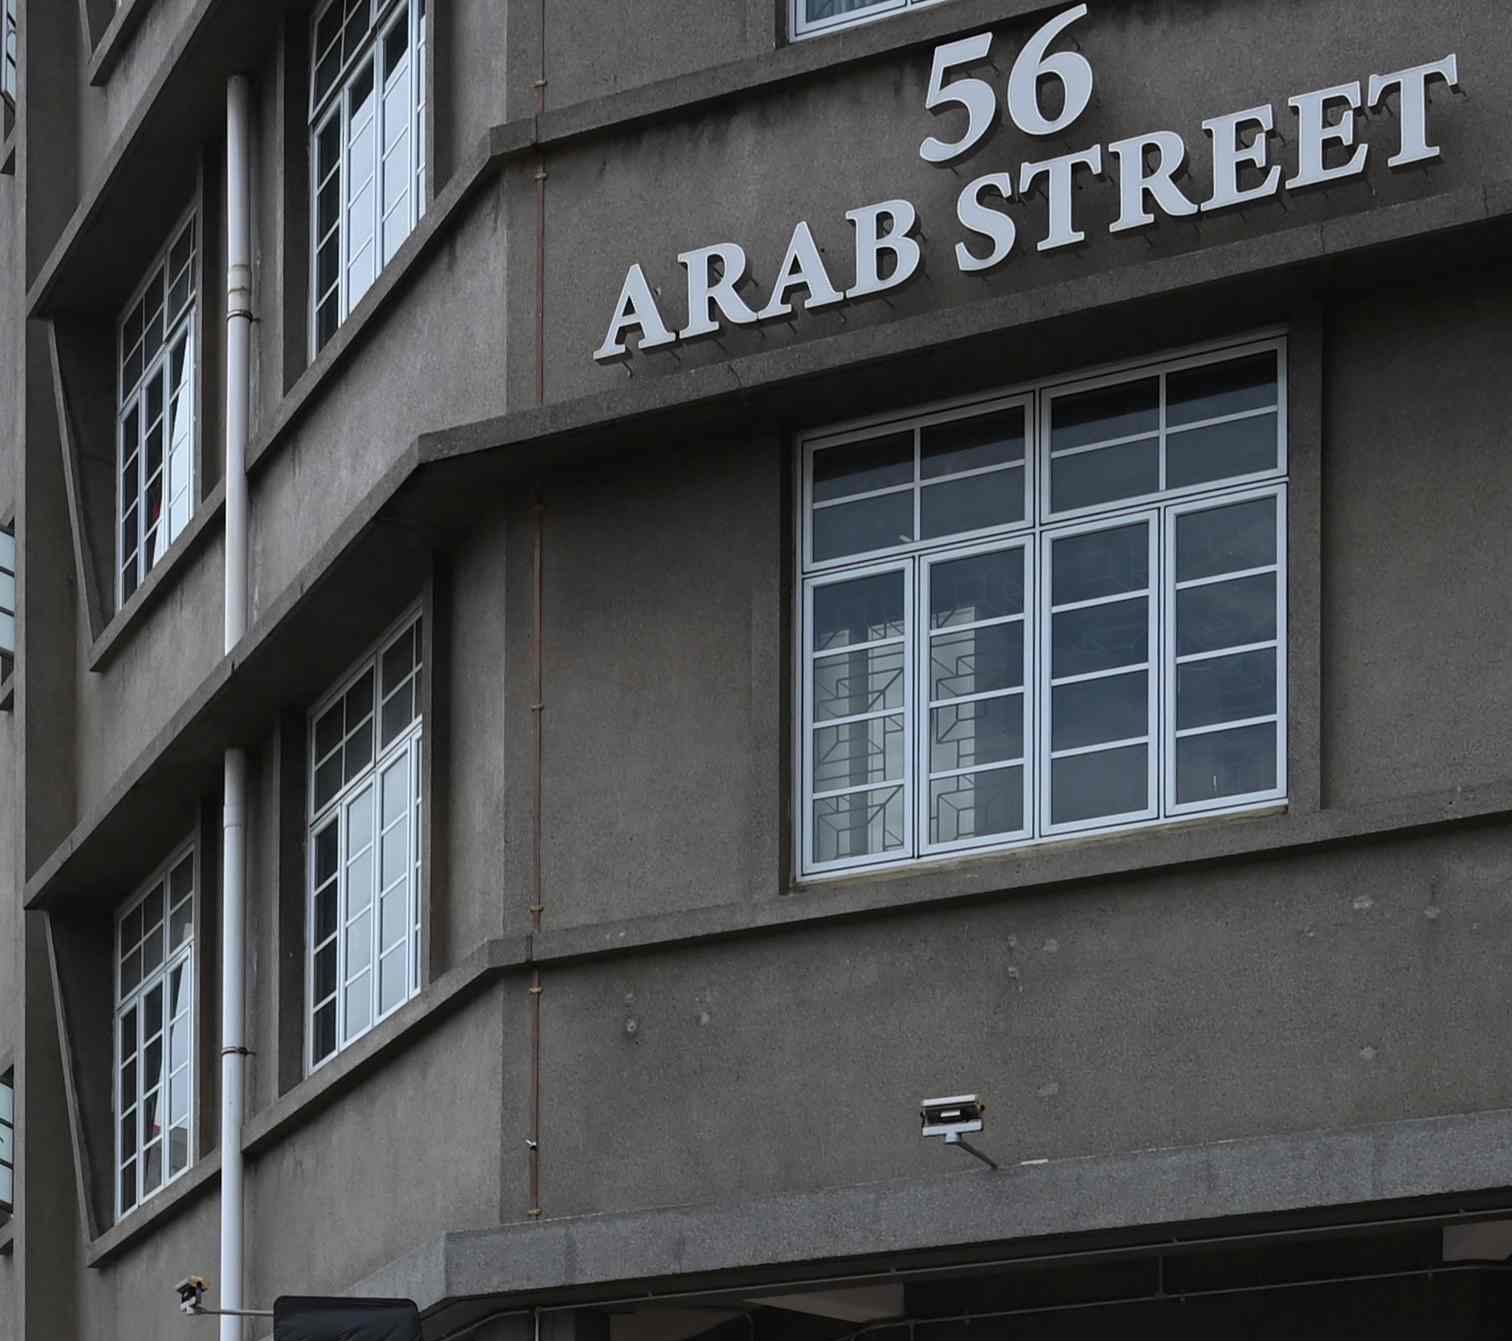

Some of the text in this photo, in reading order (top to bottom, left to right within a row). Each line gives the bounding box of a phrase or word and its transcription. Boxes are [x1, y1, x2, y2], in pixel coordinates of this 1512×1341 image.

[918, 3, 1094, 163] 56
[593, 53, 1458, 361] ARAB STREET
